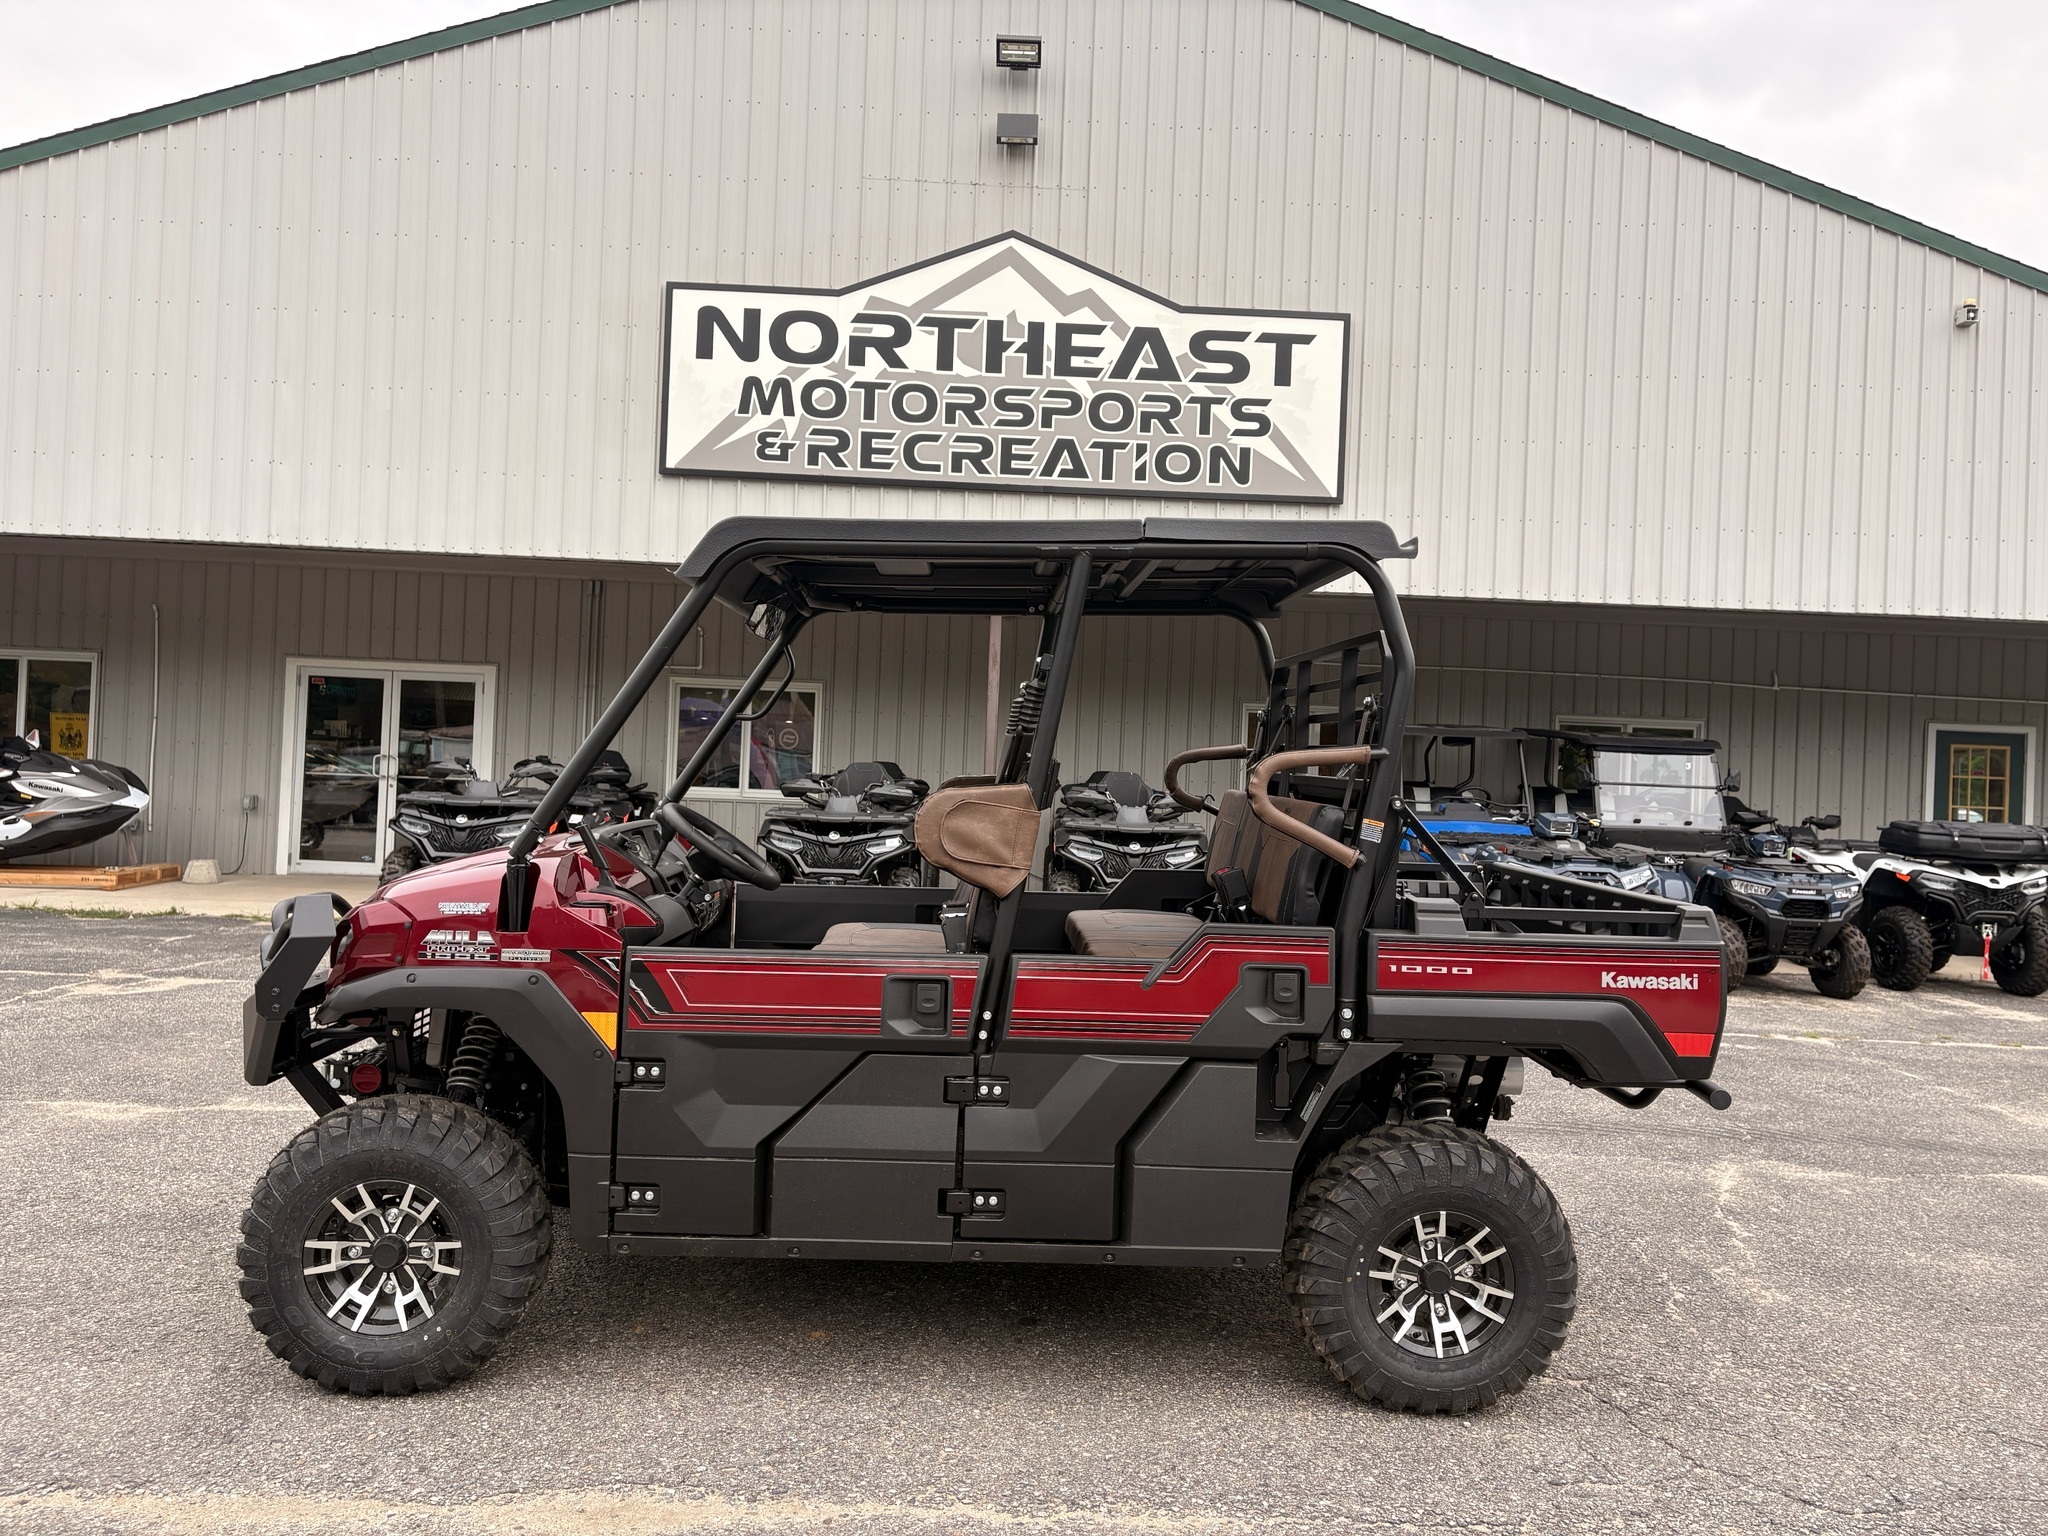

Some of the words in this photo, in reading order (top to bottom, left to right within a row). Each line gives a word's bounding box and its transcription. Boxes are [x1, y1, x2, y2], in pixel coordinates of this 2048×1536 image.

[694, 304, 1318, 388] NORTHEAST
[736, 374, 1273, 438] MOTORSPORTS
[28, 781, 64, 793] Kawasaki
[420, 930, 497, 946] MULE
[1389, 964, 1473, 975] 1000
[1601, 971, 1699, 990] Kawasaki
